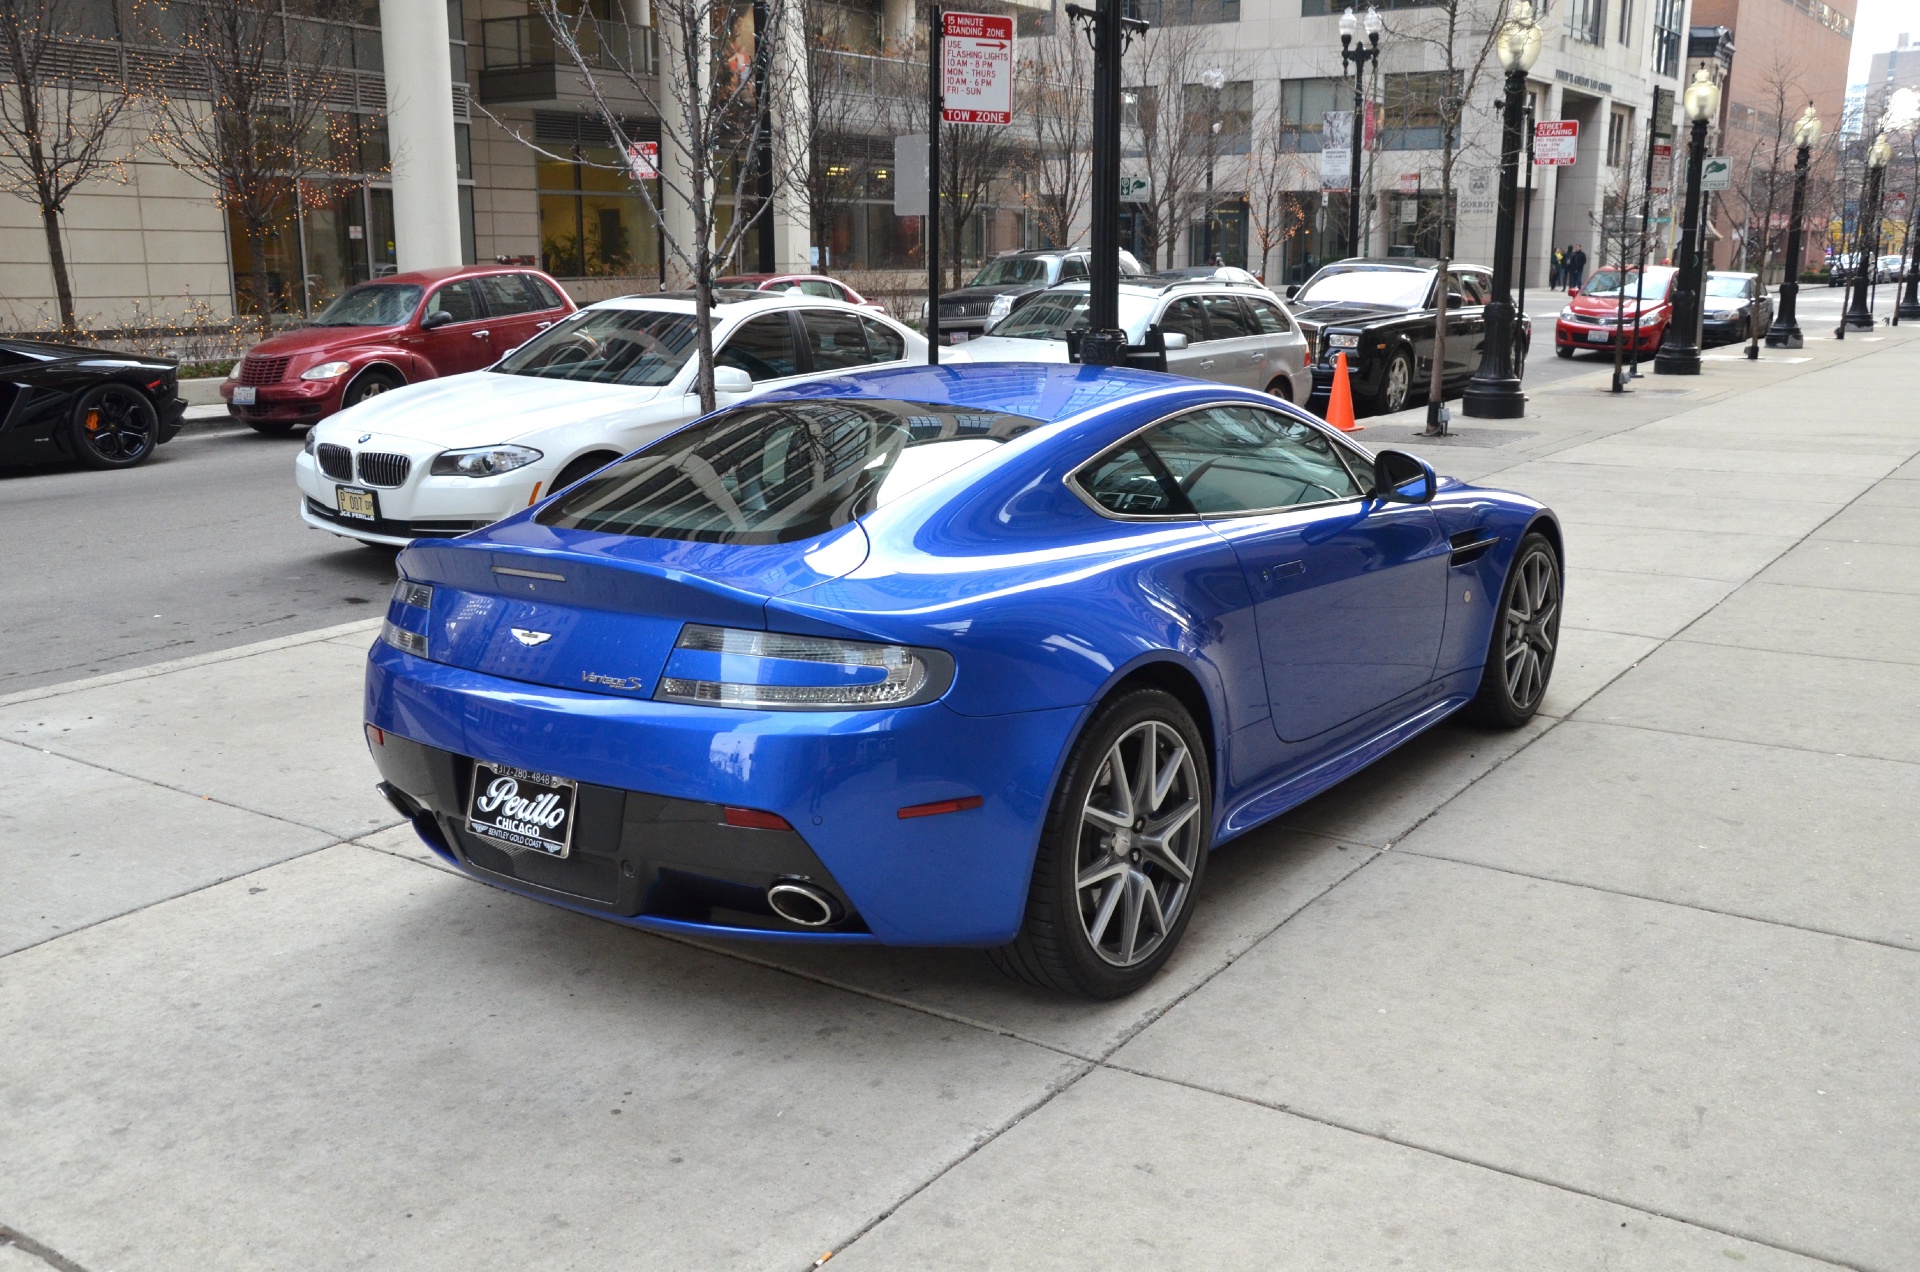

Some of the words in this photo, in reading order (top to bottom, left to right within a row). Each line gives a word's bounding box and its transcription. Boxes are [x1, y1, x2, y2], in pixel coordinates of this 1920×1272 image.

[947, 15, 955, 25] 15
[957, 17, 984, 27] MINUTE
[947, 25, 983, 36] STANDING
[986, 28, 1005, 38] ZONE
[947, 40, 962, 49] USE
[946, 49, 983, 60] FLASHING
[983, 51, 1009, 62] LIGHTS
[947, 68, 963, 76] MON
[971, 69, 996, 78] THURS
[946, 85, 959, 95] FRI
[965, 87, 982, 96] SUN
[946, 109, 971, 121] TOW
[975, 111, 1005, 123] ZONE
[350, 495, 363, 511] 007
[351, 513, 375, 521] PERILLO
[582, 670, 627, 688] Vantage
[628, 676, 642, 691] S
[498, 765, 550, 785] 312-280-4848
[477, 776, 566, 830] Perillo
[495, 815, 541, 838] CHICAGO
[488, 827, 510, 841] BENTLEY
[509, 833, 525, 845] GOLD
[524, 838, 543, 850] COAST
